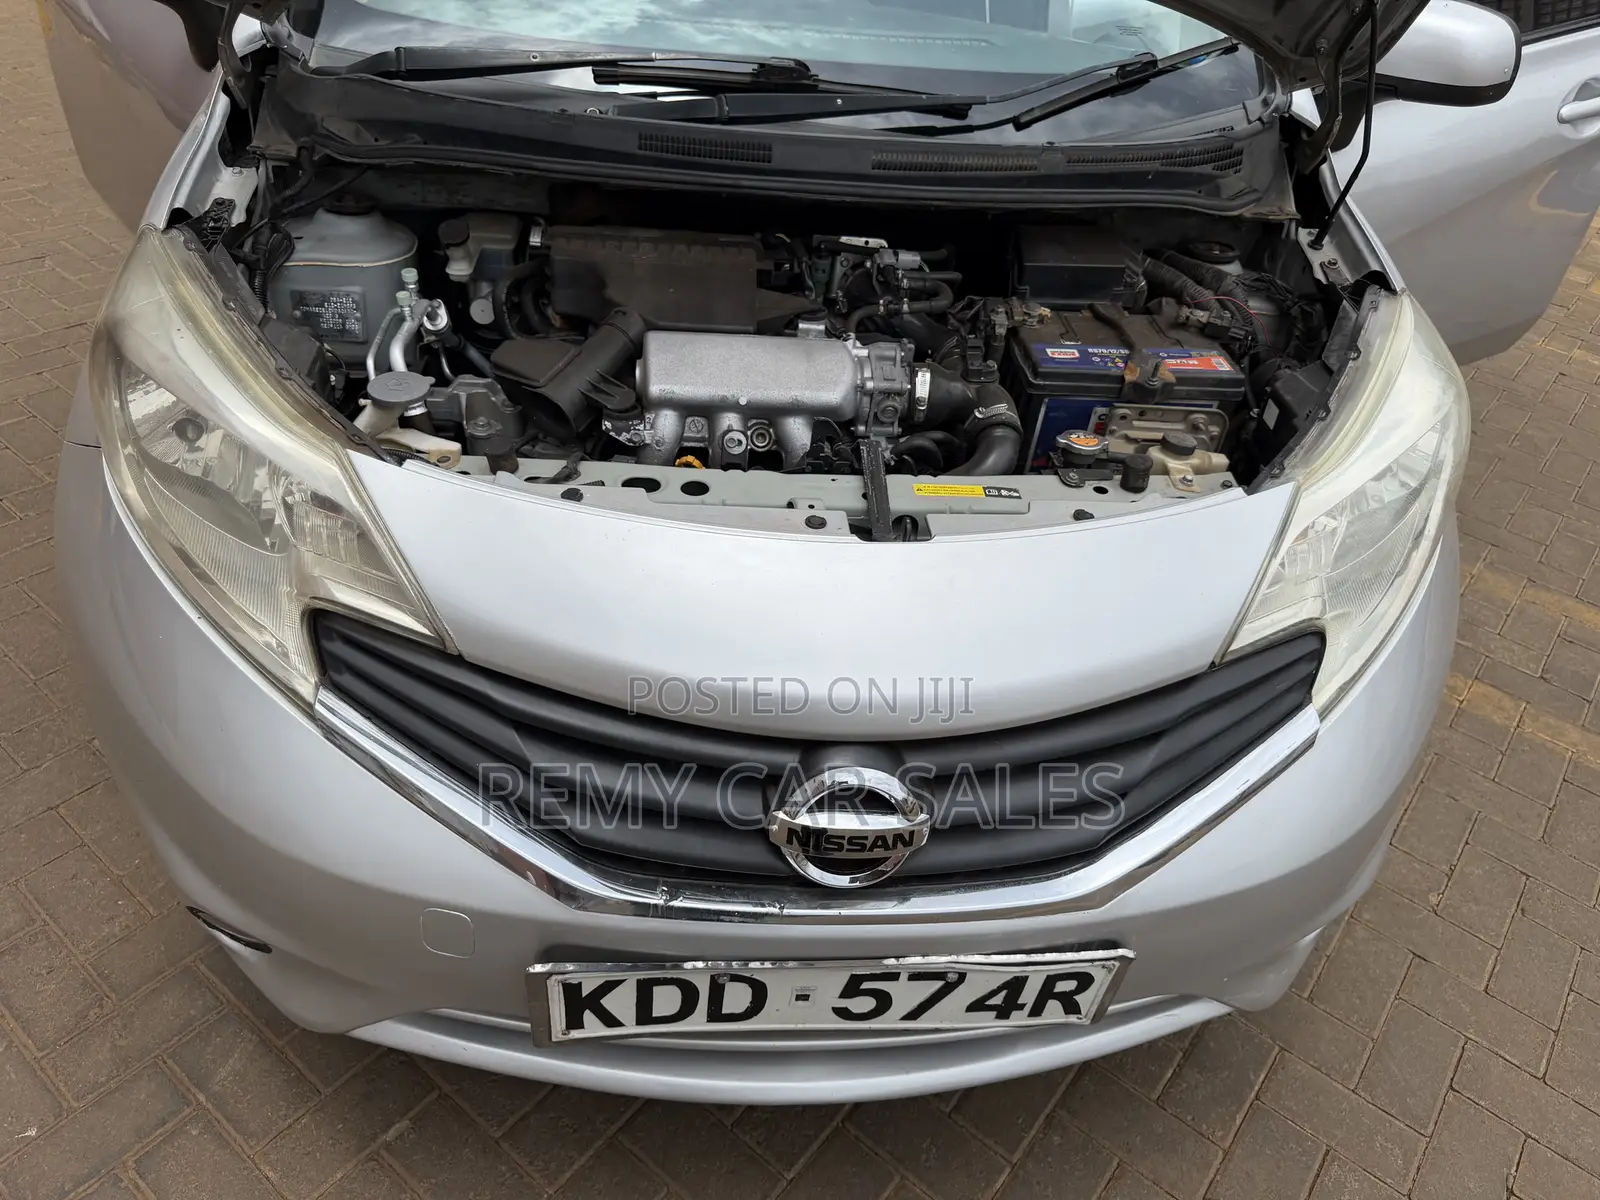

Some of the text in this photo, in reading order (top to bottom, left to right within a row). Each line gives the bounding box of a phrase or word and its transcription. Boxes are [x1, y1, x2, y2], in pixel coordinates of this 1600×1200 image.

[784, 826, 917, 855] NISSAN
[562, 970, 1096, 1031] KDD 574R
